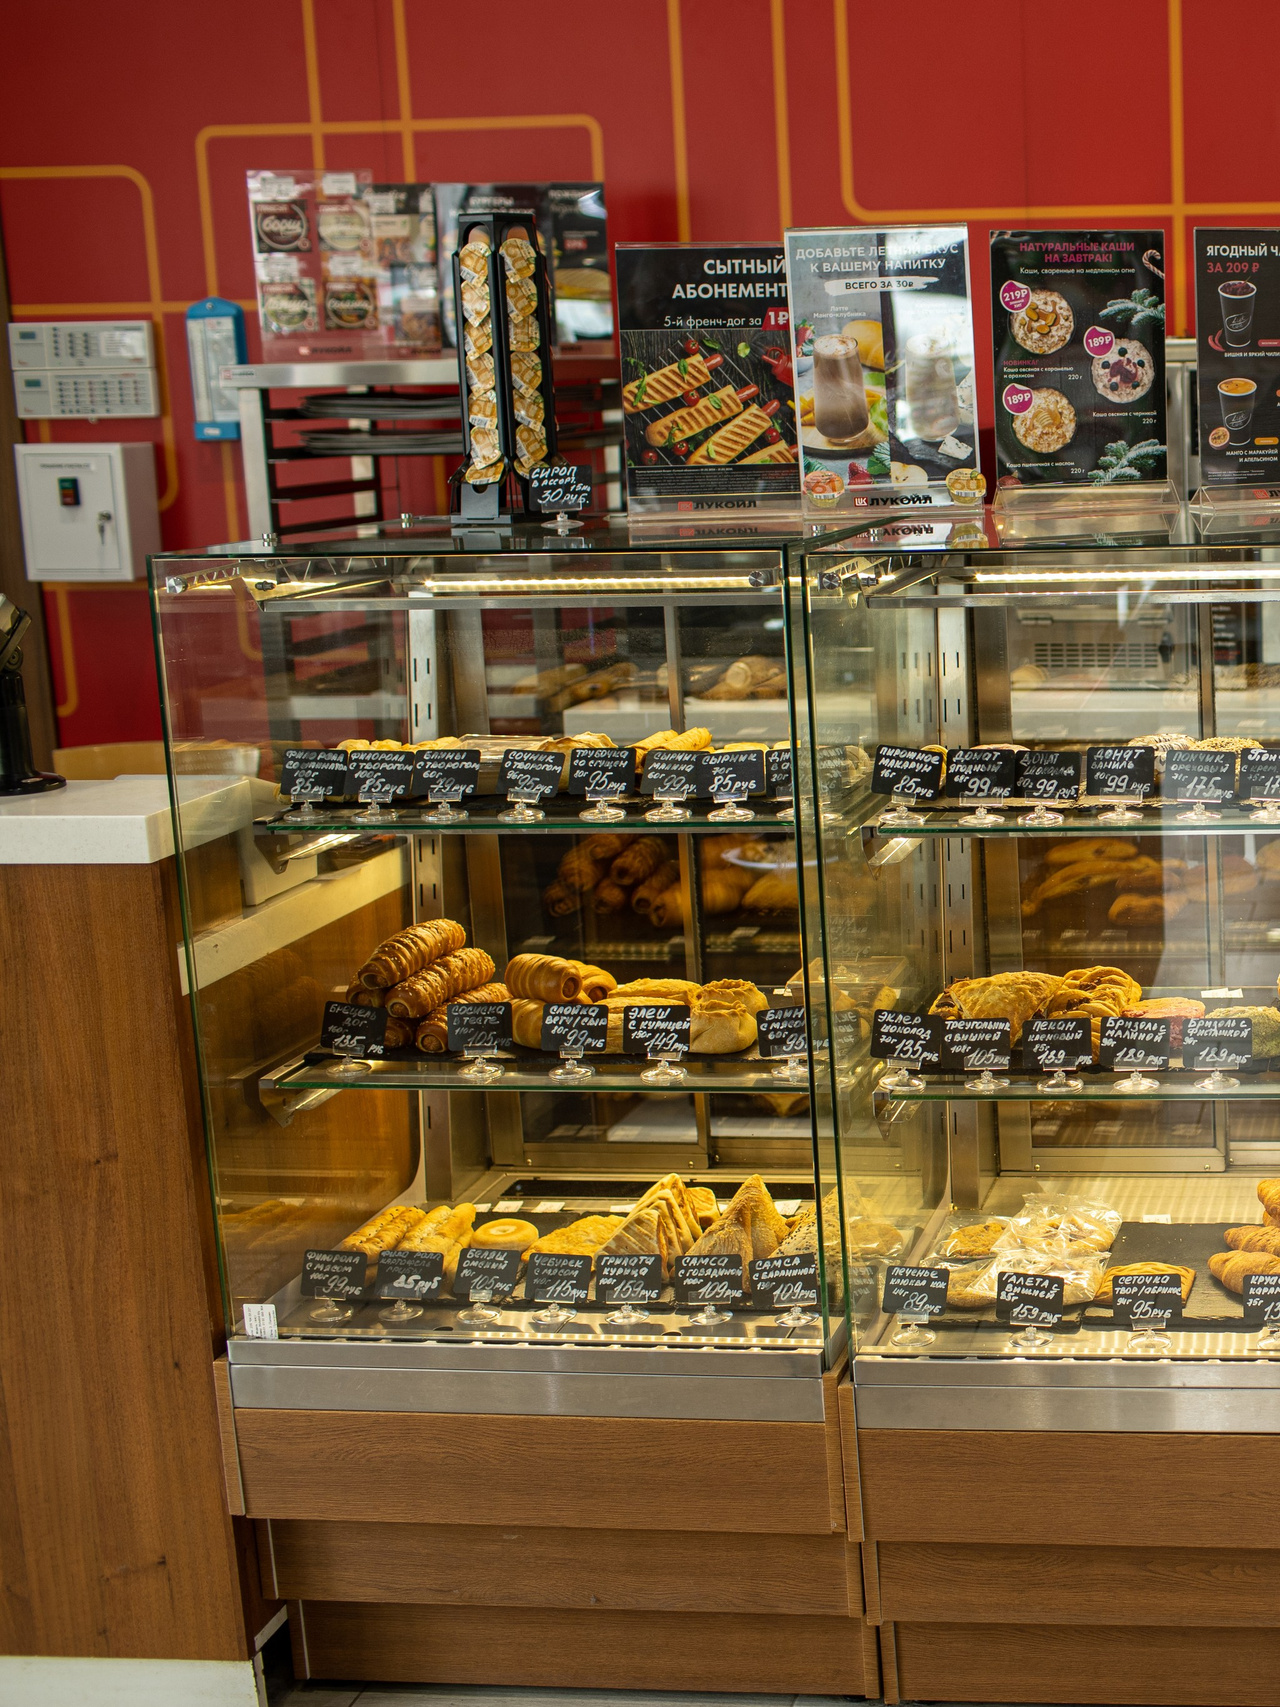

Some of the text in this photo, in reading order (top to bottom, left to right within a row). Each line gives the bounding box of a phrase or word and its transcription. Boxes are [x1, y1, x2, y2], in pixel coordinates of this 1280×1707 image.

[796, 246, 865, 260] ДОБАВЬТЕ
[926, 243, 958, 255] ВКУС
[1020, 242, 1134, 251] НАТУРАЛЬНЫЕ КАШИ
[1206, 243, 1268, 258] ЯГОДНЫЙ
[703, 255, 787, 274] СЫТНЫЙ
[810, 258, 946, 273] К ВАШЕМУ НАПИТКУ
[1045, 254, 1112, 262] НА ЗАВТРАК!
[1207, 263, 1223, 273] ЗА
[1226, 262, 1249, 272] 209
[672, 283, 788, 299] АБОНЕМЕНТ
[845, 280, 878, 290] ВСЕГО
[880, 280, 893, 289] ЗА
[664, 316, 683, 327] 5-й
[686, 315, 746, 330] френч-дог
[869, 494, 933, 506] ЛУКОЙЛ
